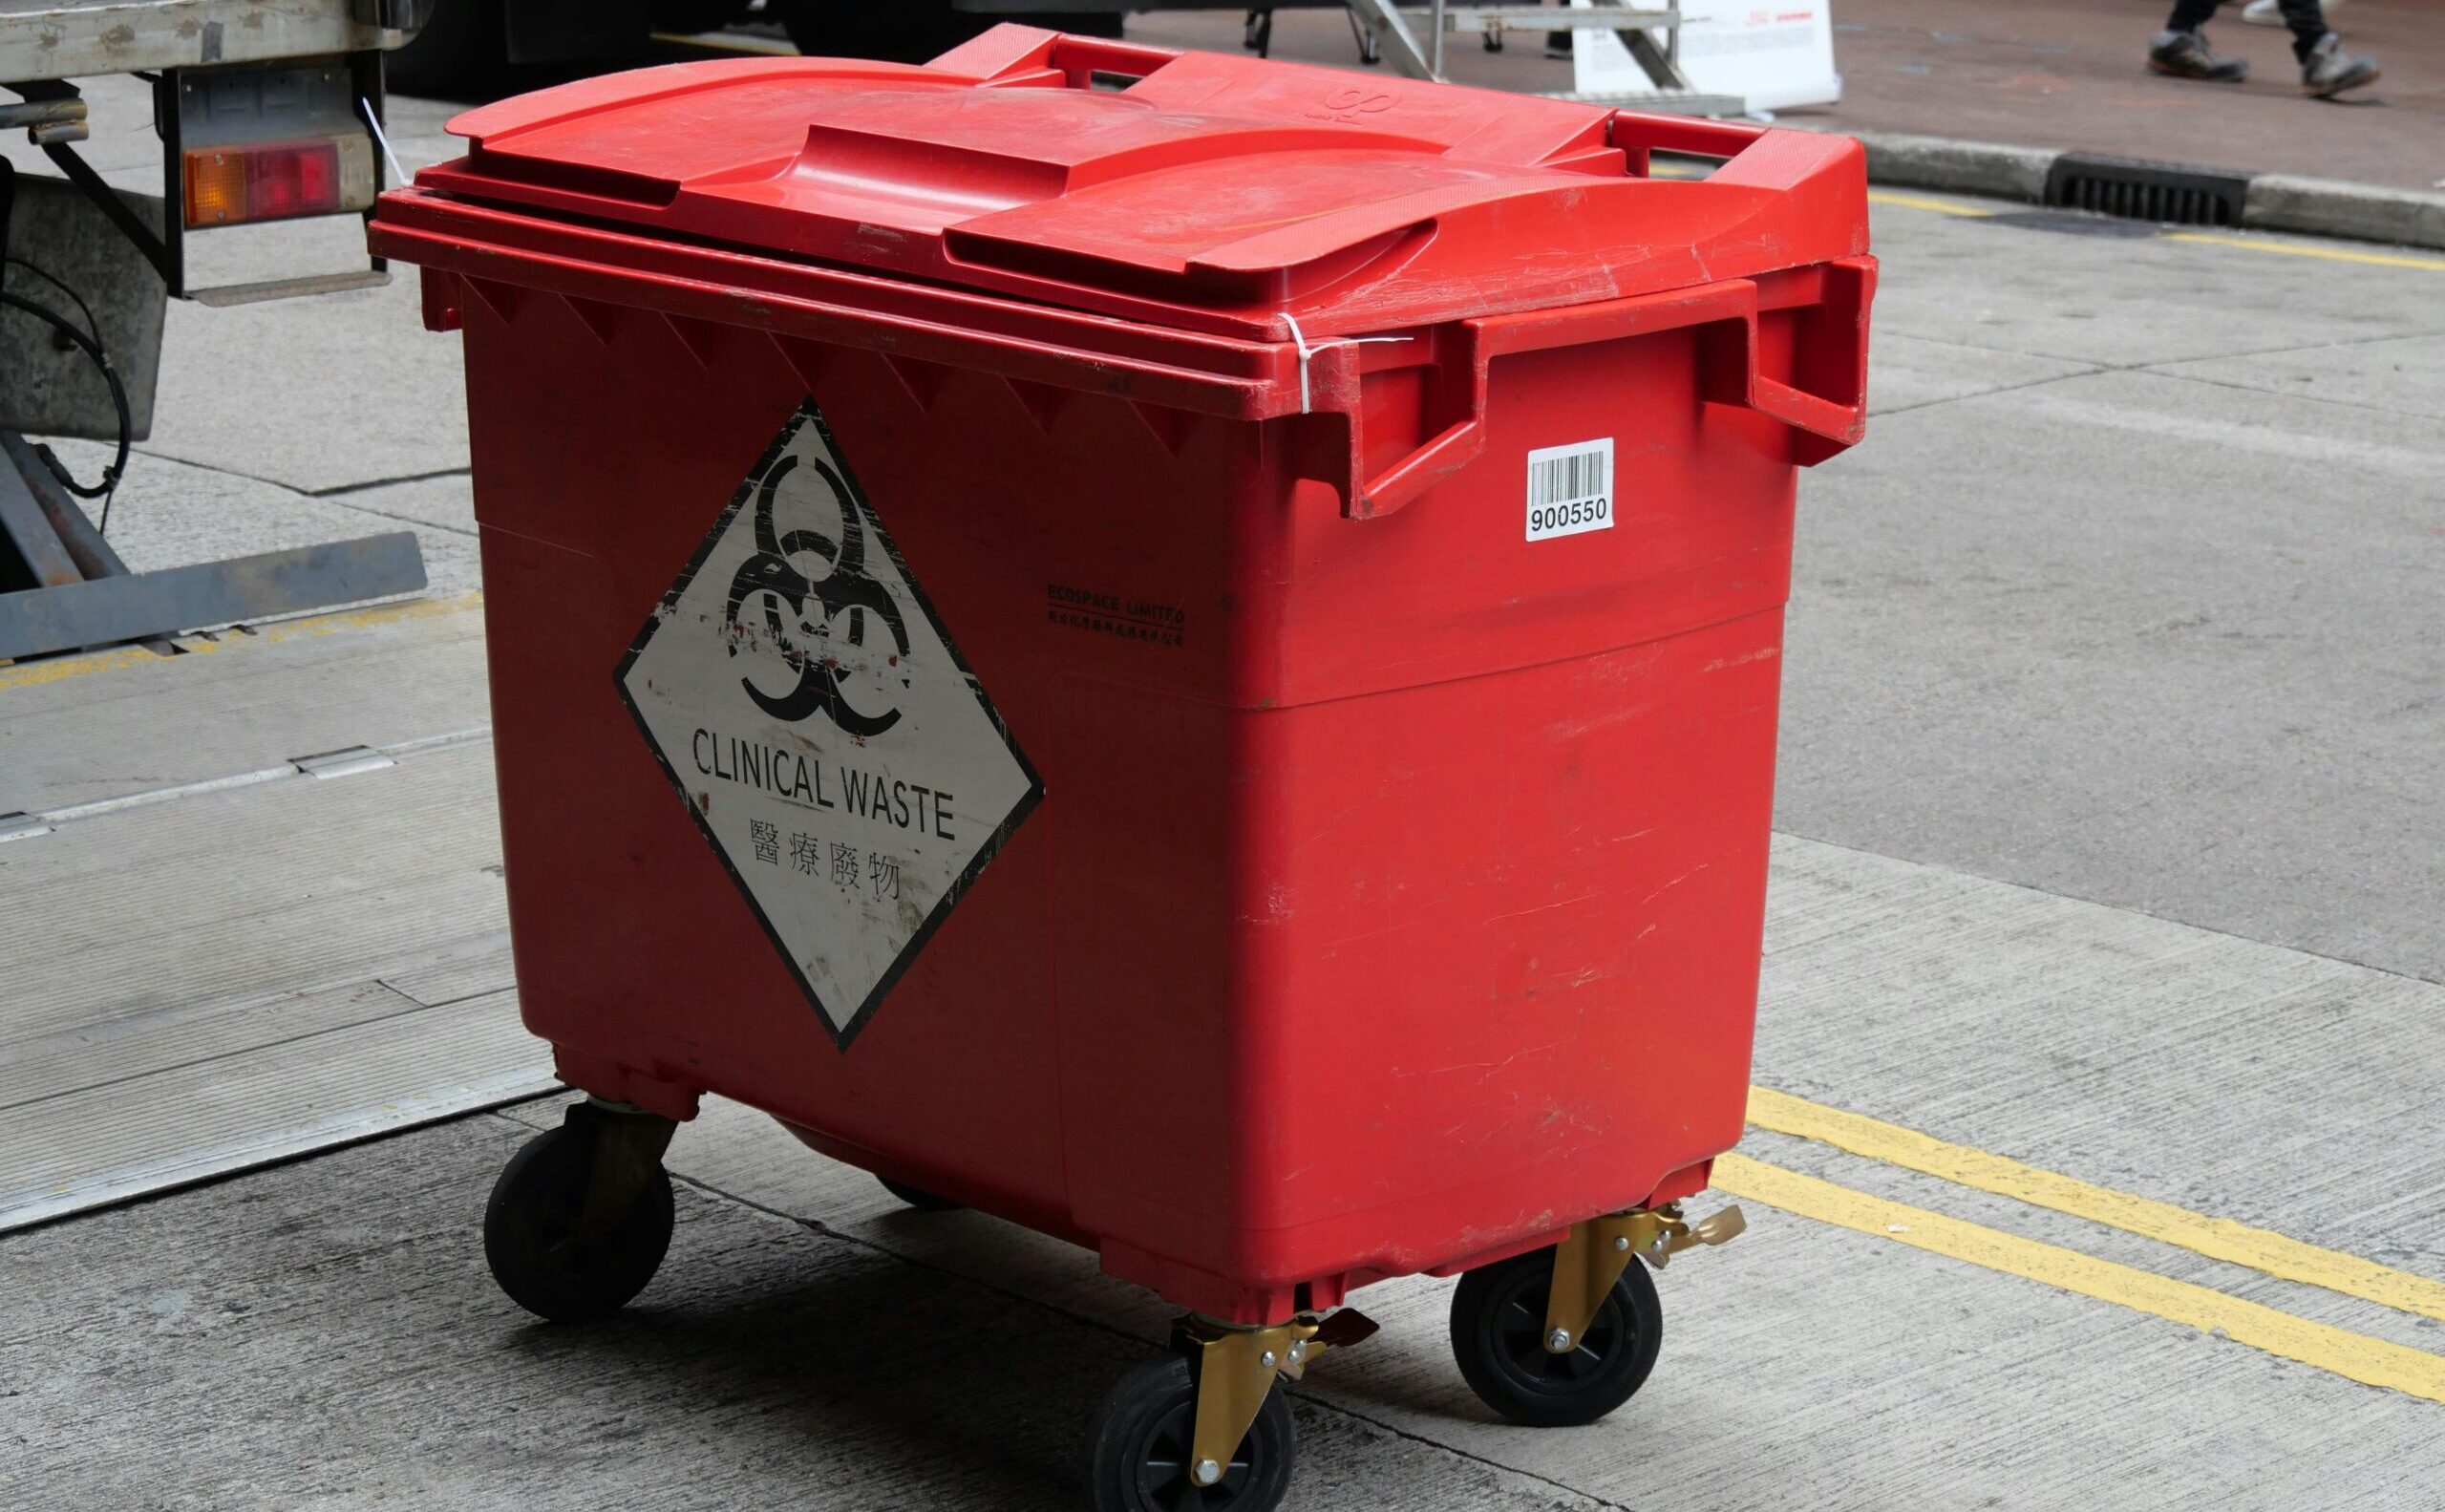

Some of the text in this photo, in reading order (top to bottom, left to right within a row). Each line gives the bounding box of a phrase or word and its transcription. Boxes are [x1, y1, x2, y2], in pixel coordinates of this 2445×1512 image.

[1531, 498, 1606, 531] 900550
[1048, 584, 1120, 611] ECOSPACE
[692, 728, 955, 841] CLINICAL WASTE
[750, 819, 900, 901] 醫療廢物
